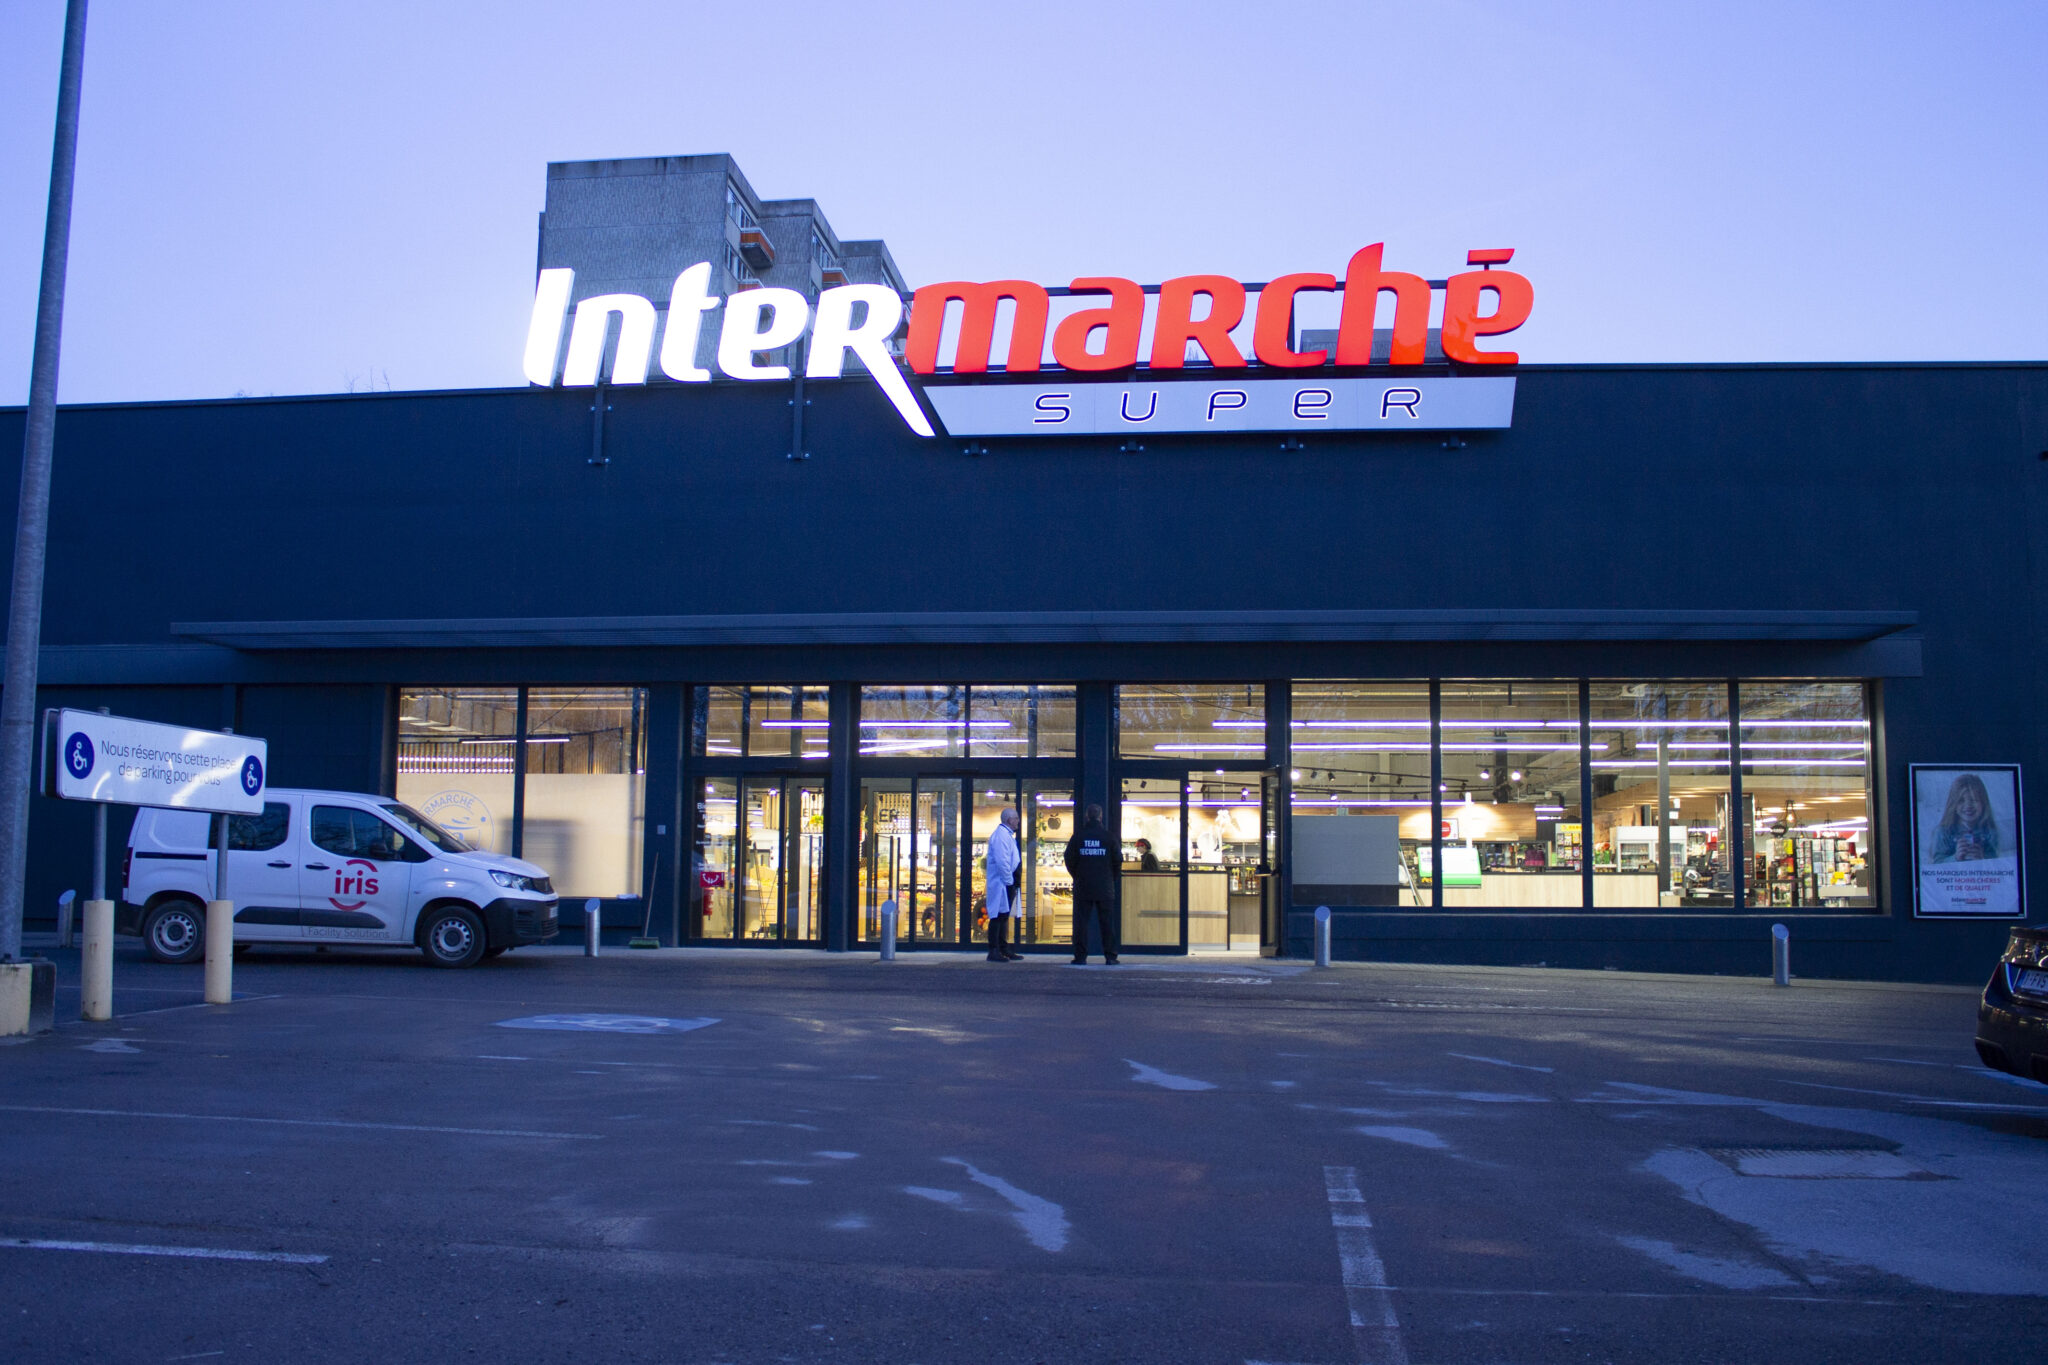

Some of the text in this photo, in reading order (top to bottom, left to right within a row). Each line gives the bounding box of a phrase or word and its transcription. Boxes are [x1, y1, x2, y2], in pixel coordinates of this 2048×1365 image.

[101, 740, 130, 757] Nous
[131, 744, 182, 764] réservons
[184, 753, 210, 767] cette
[118, 761, 133, 776] de
[134, 764, 173, 784] parking
[1079, 848, 1107, 856] SECURITY
[1084, 839, 1101, 848] TEAM
[335, 869, 379, 895] iris
[308, 926, 390, 939] Facility Solutions
